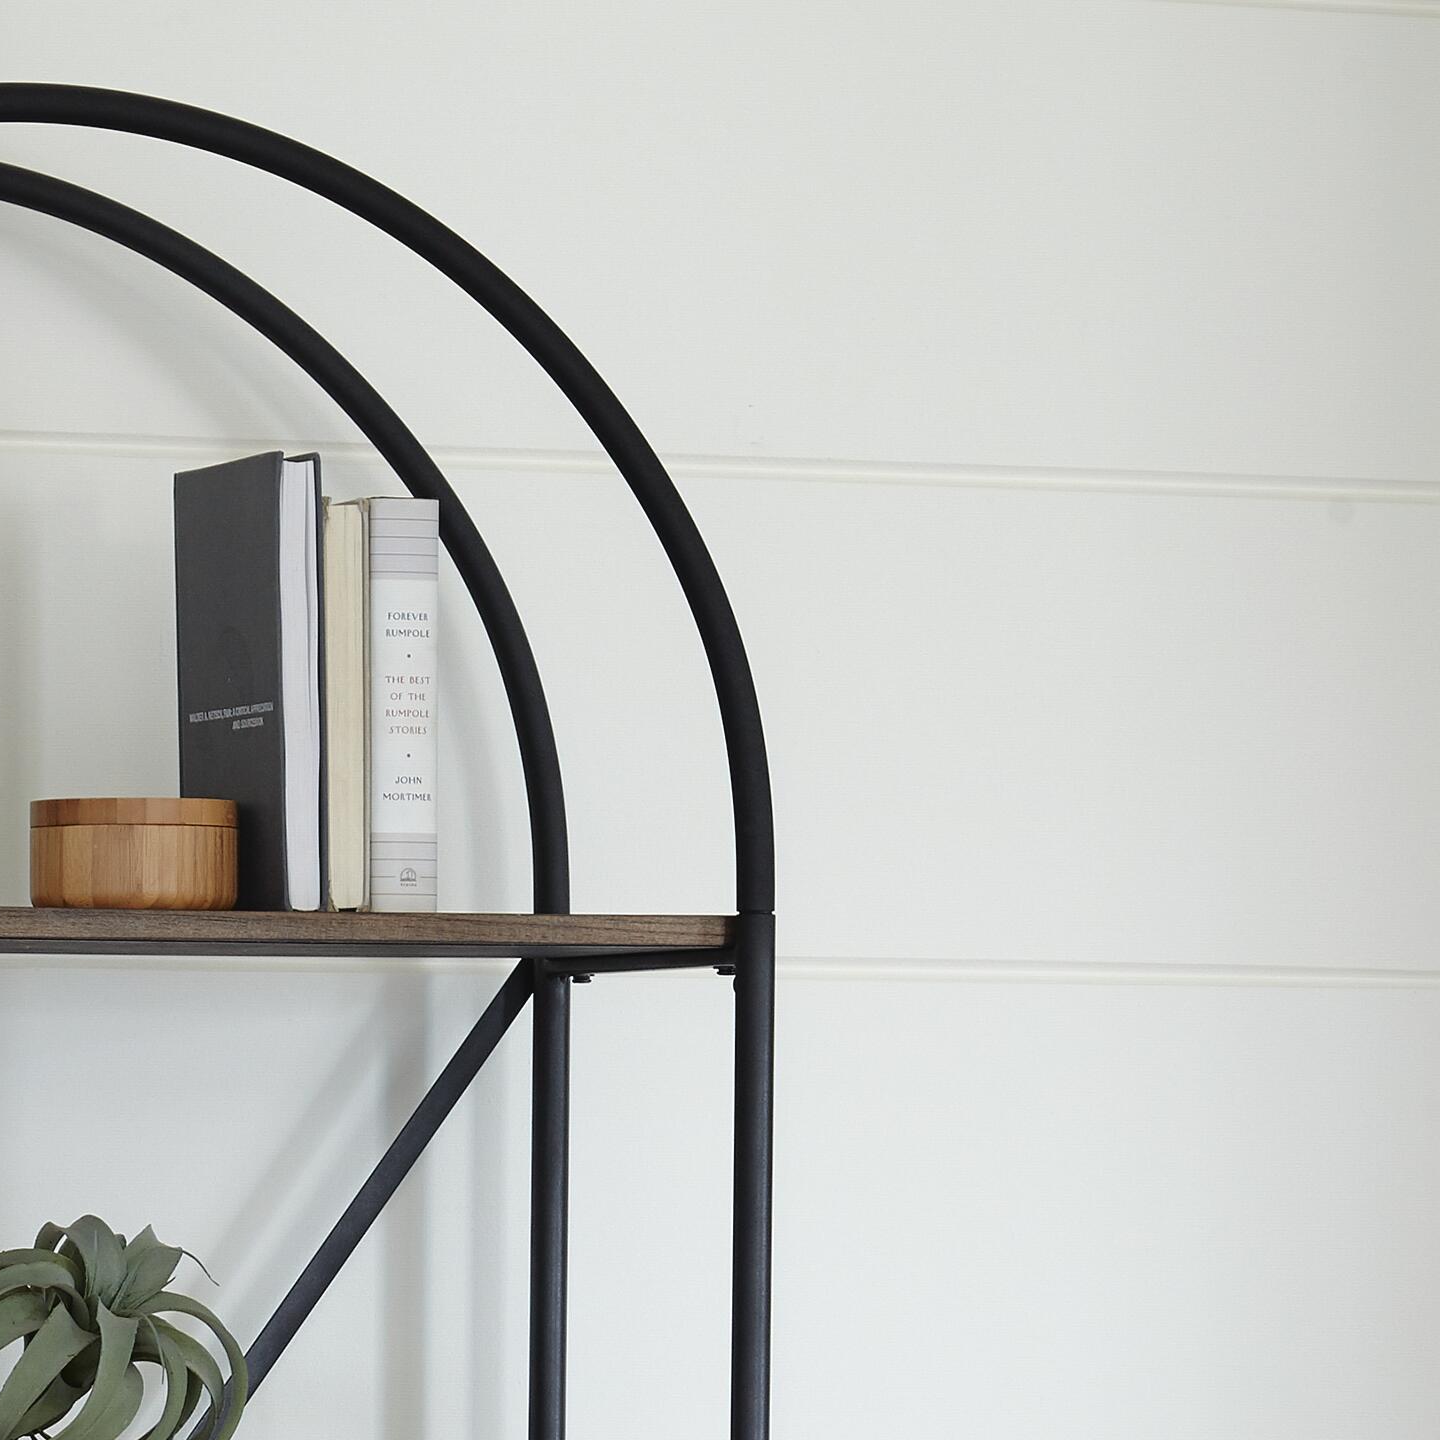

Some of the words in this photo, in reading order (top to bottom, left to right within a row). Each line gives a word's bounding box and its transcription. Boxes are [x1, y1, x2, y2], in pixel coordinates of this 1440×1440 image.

[387, 611, 429, 621] FOREVER
[385, 628, 430, 638] RUMPOLE
[385, 675, 406, 684] THE
[409, 675, 431, 685] BEST
[390, 692, 402, 701] OF
[408, 692, 426, 701] THE
[385, 708, 430, 718] RUMPOLE
[388, 725, 427, 735] STORIES
[395, 776, 423, 785] JOHN
[383, 793, 432, 802] MORTIMER
